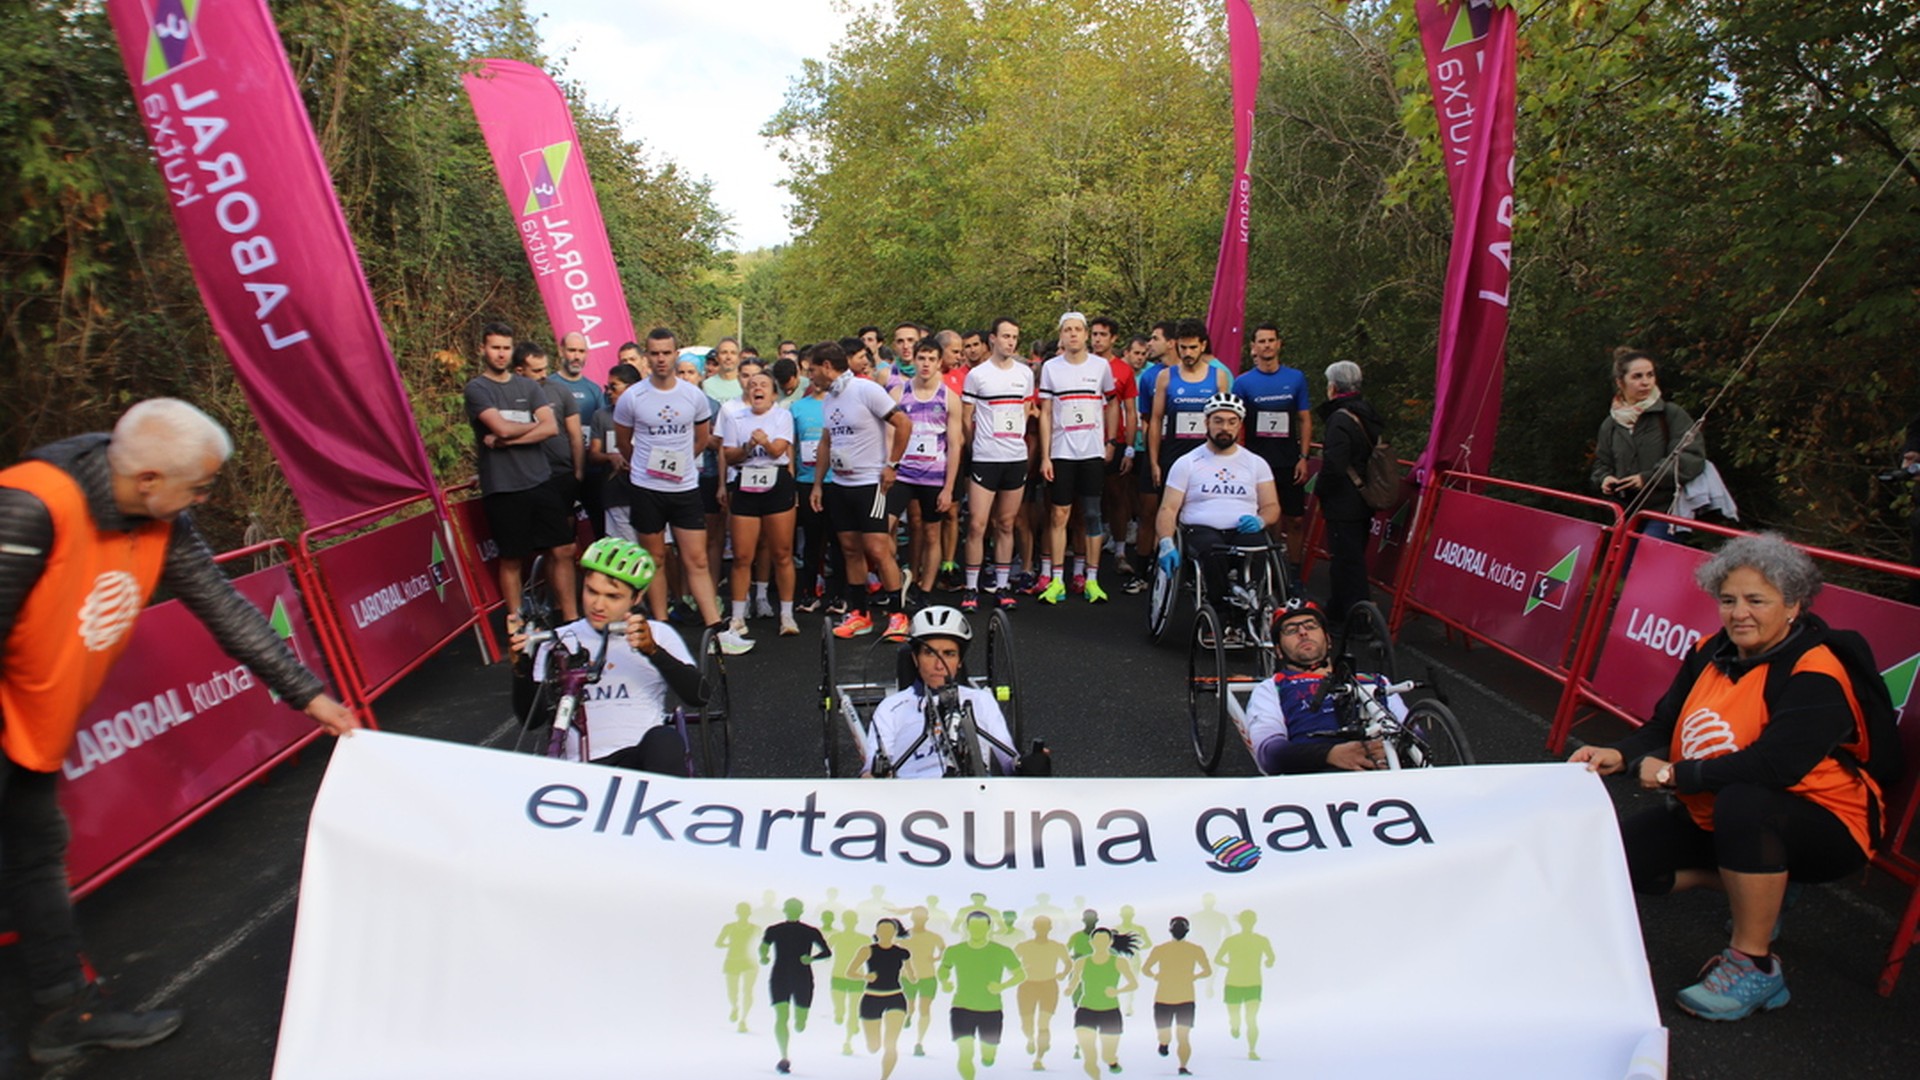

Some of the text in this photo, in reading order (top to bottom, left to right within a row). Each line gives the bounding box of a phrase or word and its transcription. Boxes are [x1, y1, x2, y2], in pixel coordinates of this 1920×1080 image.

[1075, 413, 1084, 423] 3
[647, 424, 688, 436] LANA
[1005, 421, 1014, 431] 3
[1189, 421, 1198, 431] 7
[1269, 420, 1278, 430] 7
[916, 443, 926, 453] 4
[659, 459, 677, 472] 14
[751, 474, 769, 485] 14
[1201, 484, 1248, 495] LANA
[1433, 537, 1527, 592] LABORAL kutxa
[350, 574, 433, 630] LABORAL kutxa
[1626, 607, 1702, 661] LABOR
[61, 663, 256, 781] LABORAL kutxa
[525, 775, 1435, 874] elkartasuna gara
